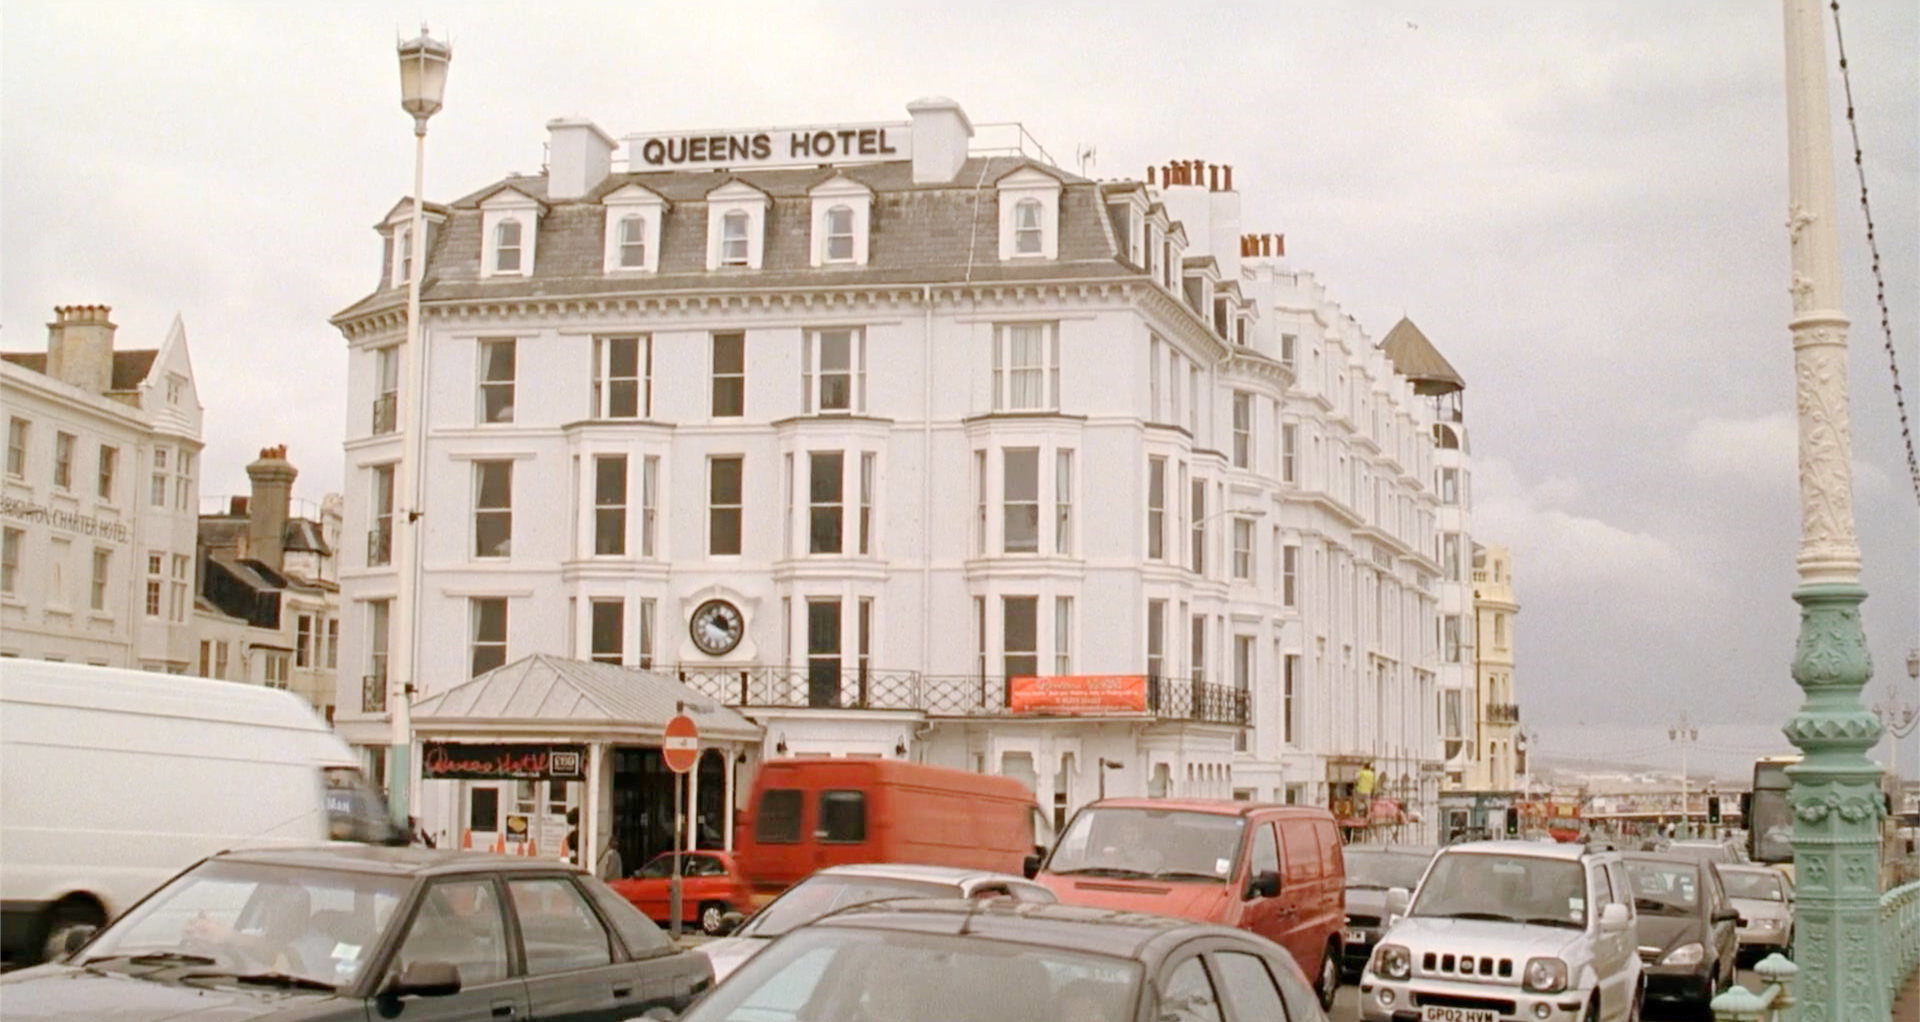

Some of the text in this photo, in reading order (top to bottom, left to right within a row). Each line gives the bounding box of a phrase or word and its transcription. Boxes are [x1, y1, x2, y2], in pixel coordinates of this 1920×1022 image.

[643, 129, 896, 165] QUEENS HOTEL
[52, 509, 97, 536] CHARTER
[99, 519, 129, 544] HOTEL
[1427, 1007, 1463, 1022] GP02
